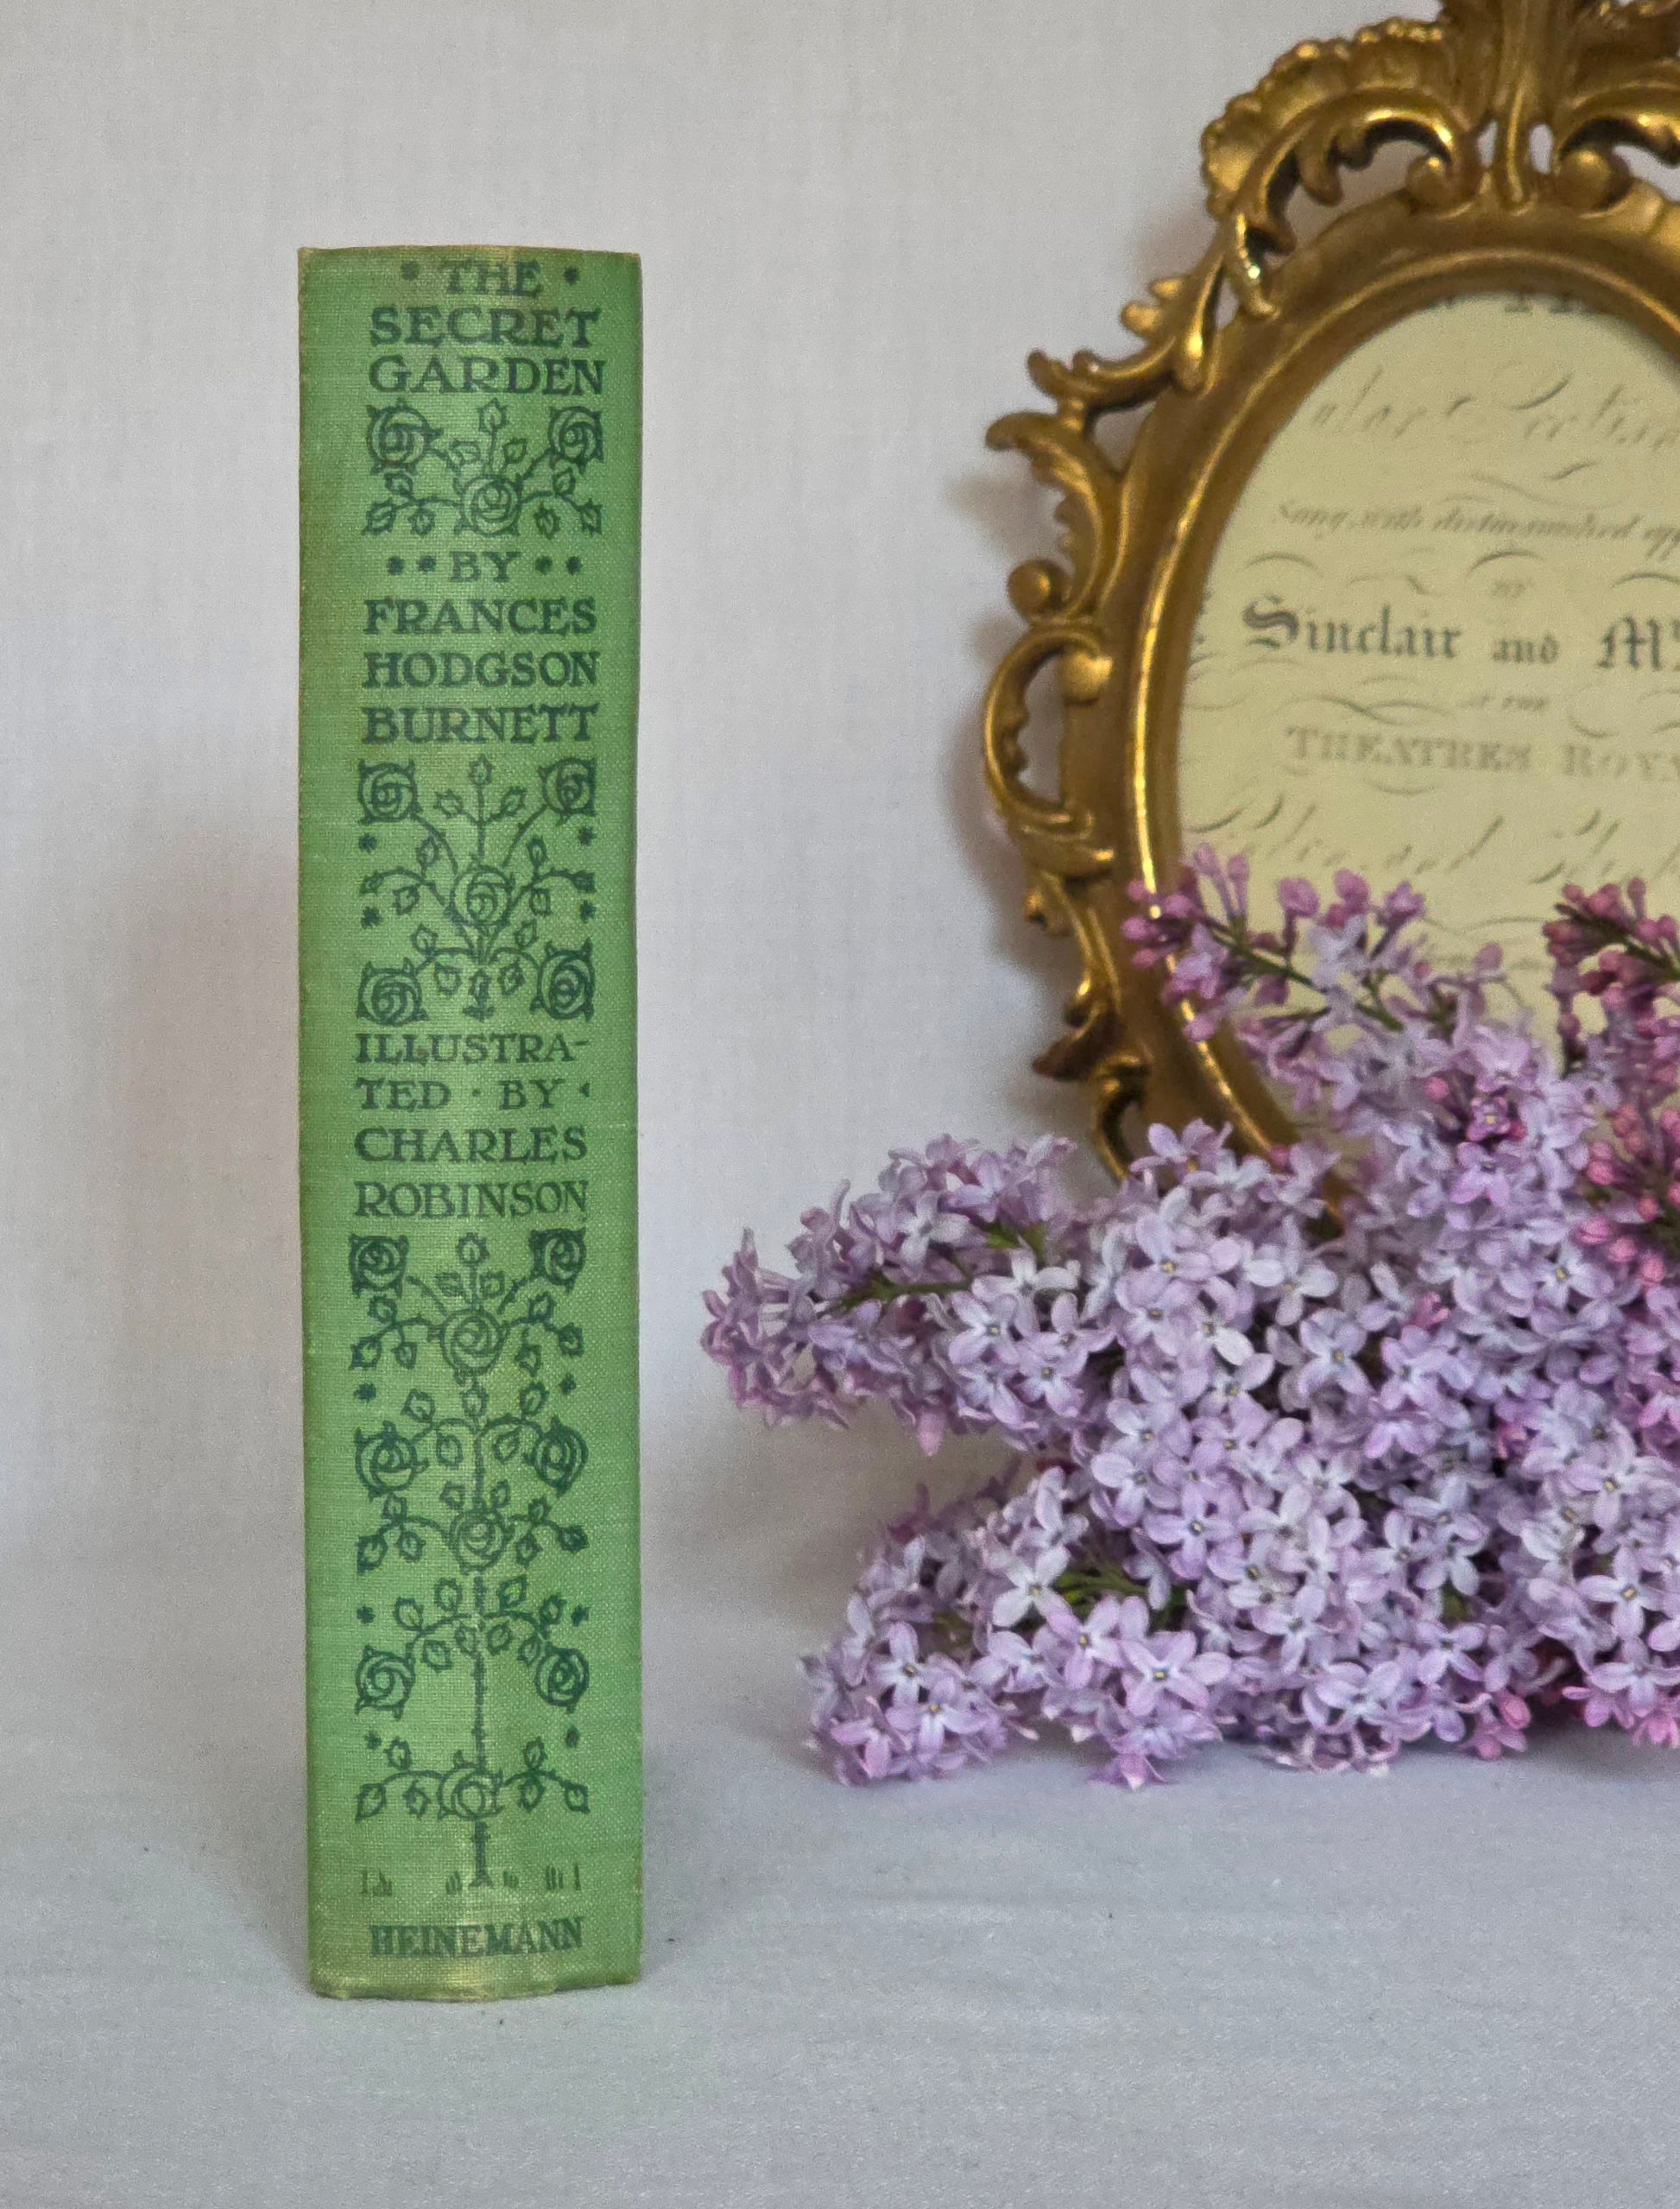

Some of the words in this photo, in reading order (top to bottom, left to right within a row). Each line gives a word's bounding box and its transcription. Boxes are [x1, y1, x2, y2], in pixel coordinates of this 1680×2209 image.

[439, 260, 544, 296] THE
[370, 306, 602, 348] SECRET
[369, 354, 605, 396] GARDEN
[449, 552, 521, 583] BY
[363, 597, 598, 636] FRANCES
[1242, 594, 1462, 661] Sinclair
[1492, 633, 1559, 663] and
[363, 650, 600, 688] HODGSON
[362, 703, 600, 744] BURNETT
[355, 1033, 590, 1066] ILLUSTRA-
[355, 1077, 452, 1112] TED
[498, 1078, 565, 1111] BY
[354, 1125, 588, 1164] CHARLES
[354, 1180, 589, 1218] ROBINSON
[370, 1915, 584, 1958] HEINEMANN
